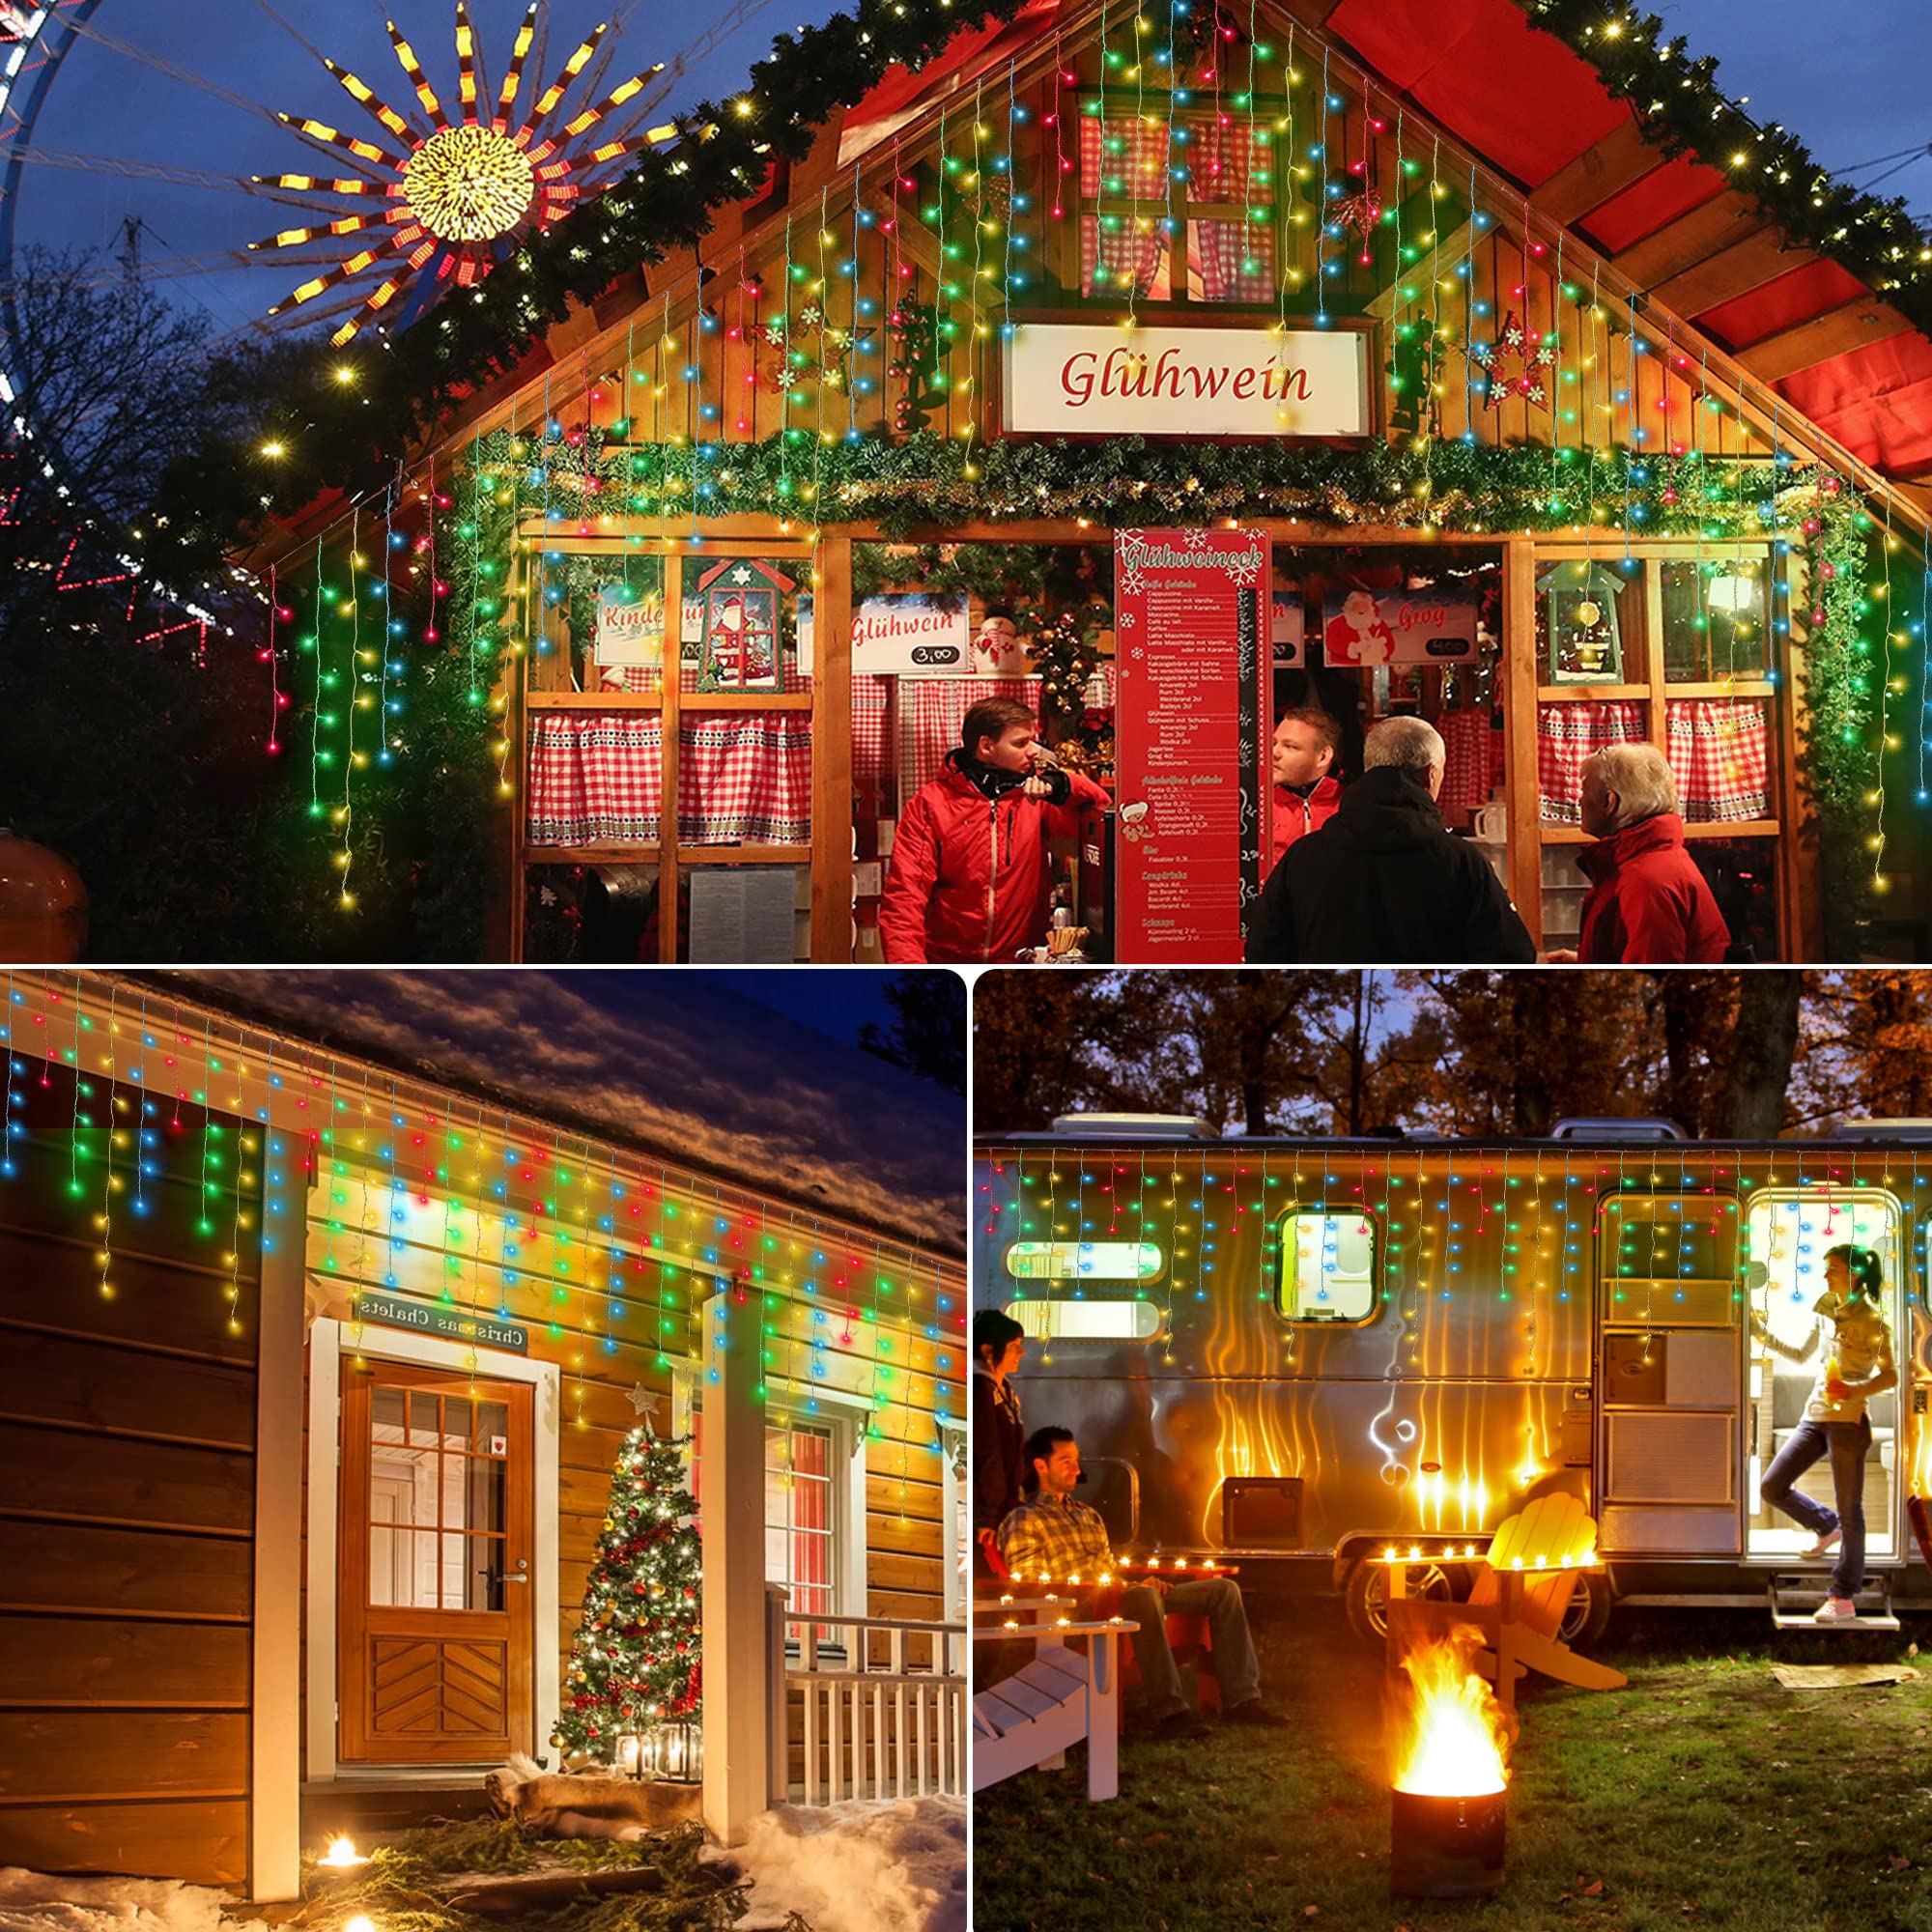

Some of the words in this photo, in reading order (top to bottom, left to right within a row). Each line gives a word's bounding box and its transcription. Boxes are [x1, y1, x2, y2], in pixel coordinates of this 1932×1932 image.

[1062, 348, 1313, 408] Glühwein
[851, 611, 953, 646] Glühwein
[1398, 603, 1446, 632] Grog
